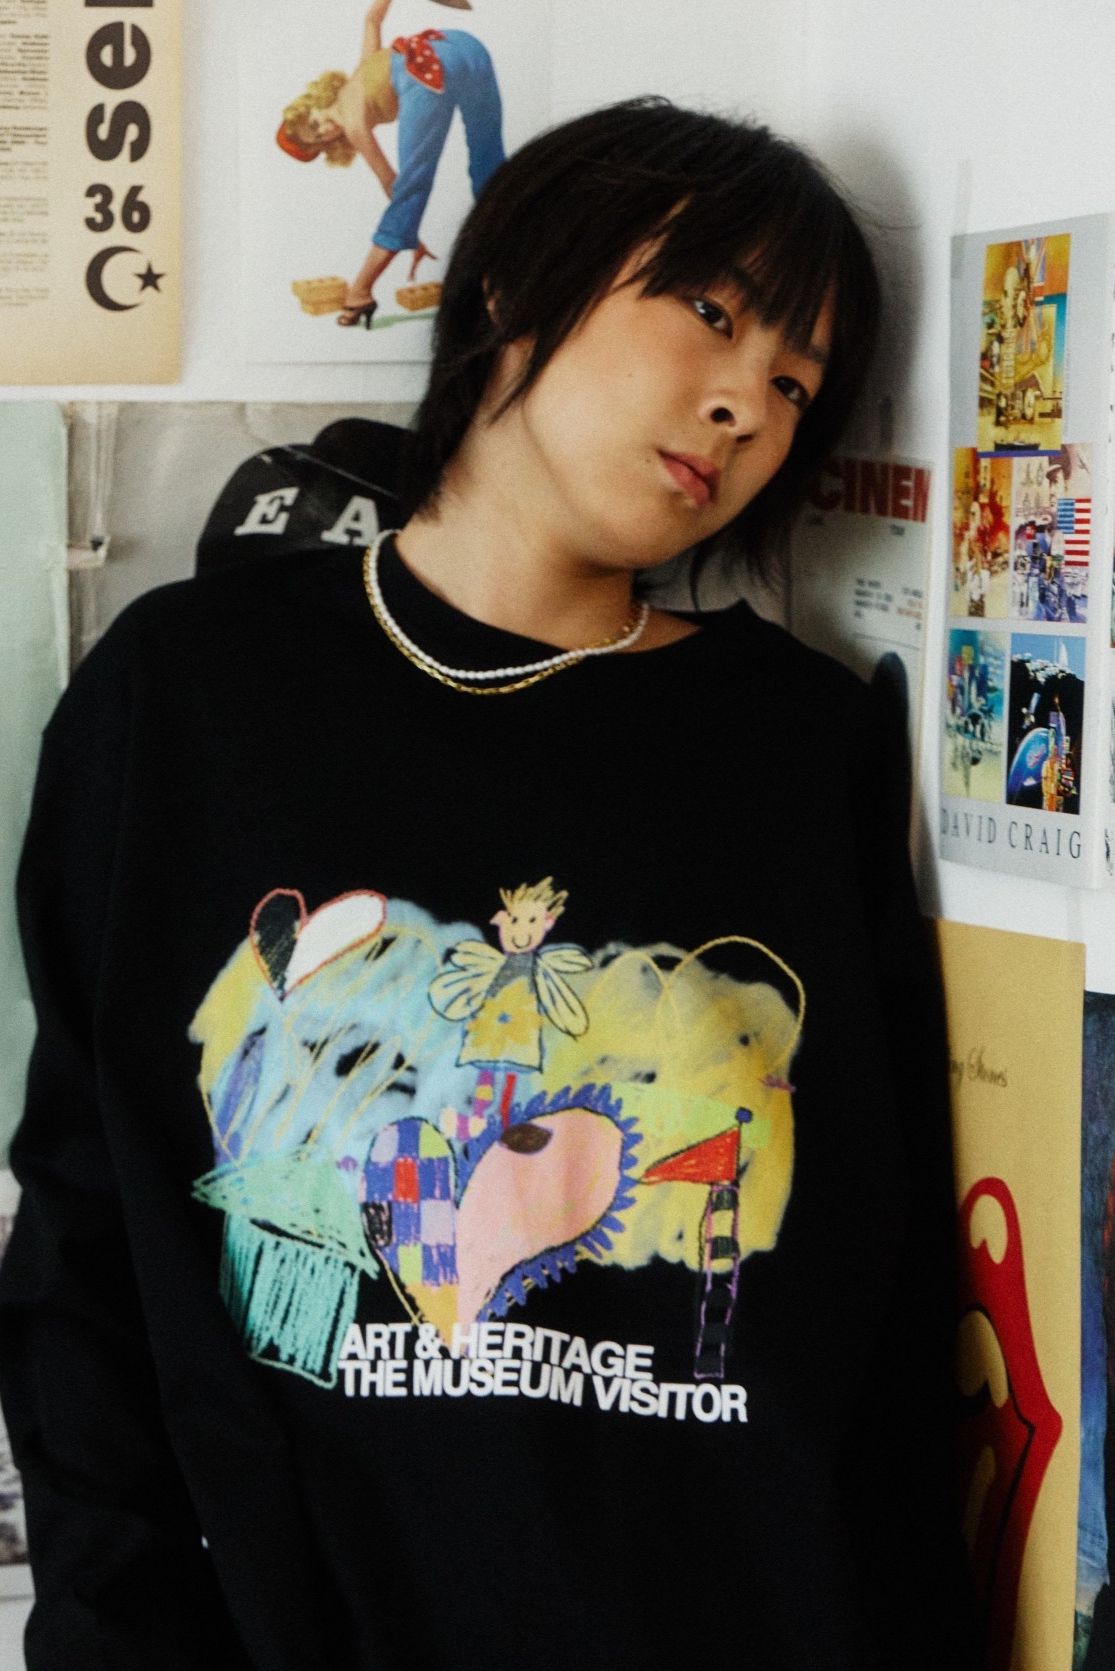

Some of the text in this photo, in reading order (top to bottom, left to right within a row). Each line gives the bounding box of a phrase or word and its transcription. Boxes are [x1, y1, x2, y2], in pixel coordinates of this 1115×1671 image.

[84, 183, 152, 233] 36
[940, 807, 997, 844] DAVID
[1008, 820, 1082, 860] CRAIG
[339, 1321, 655, 1381] ART & HERITAGE
[336, 1358, 749, 1424] THE MUSEUM VISITOR
